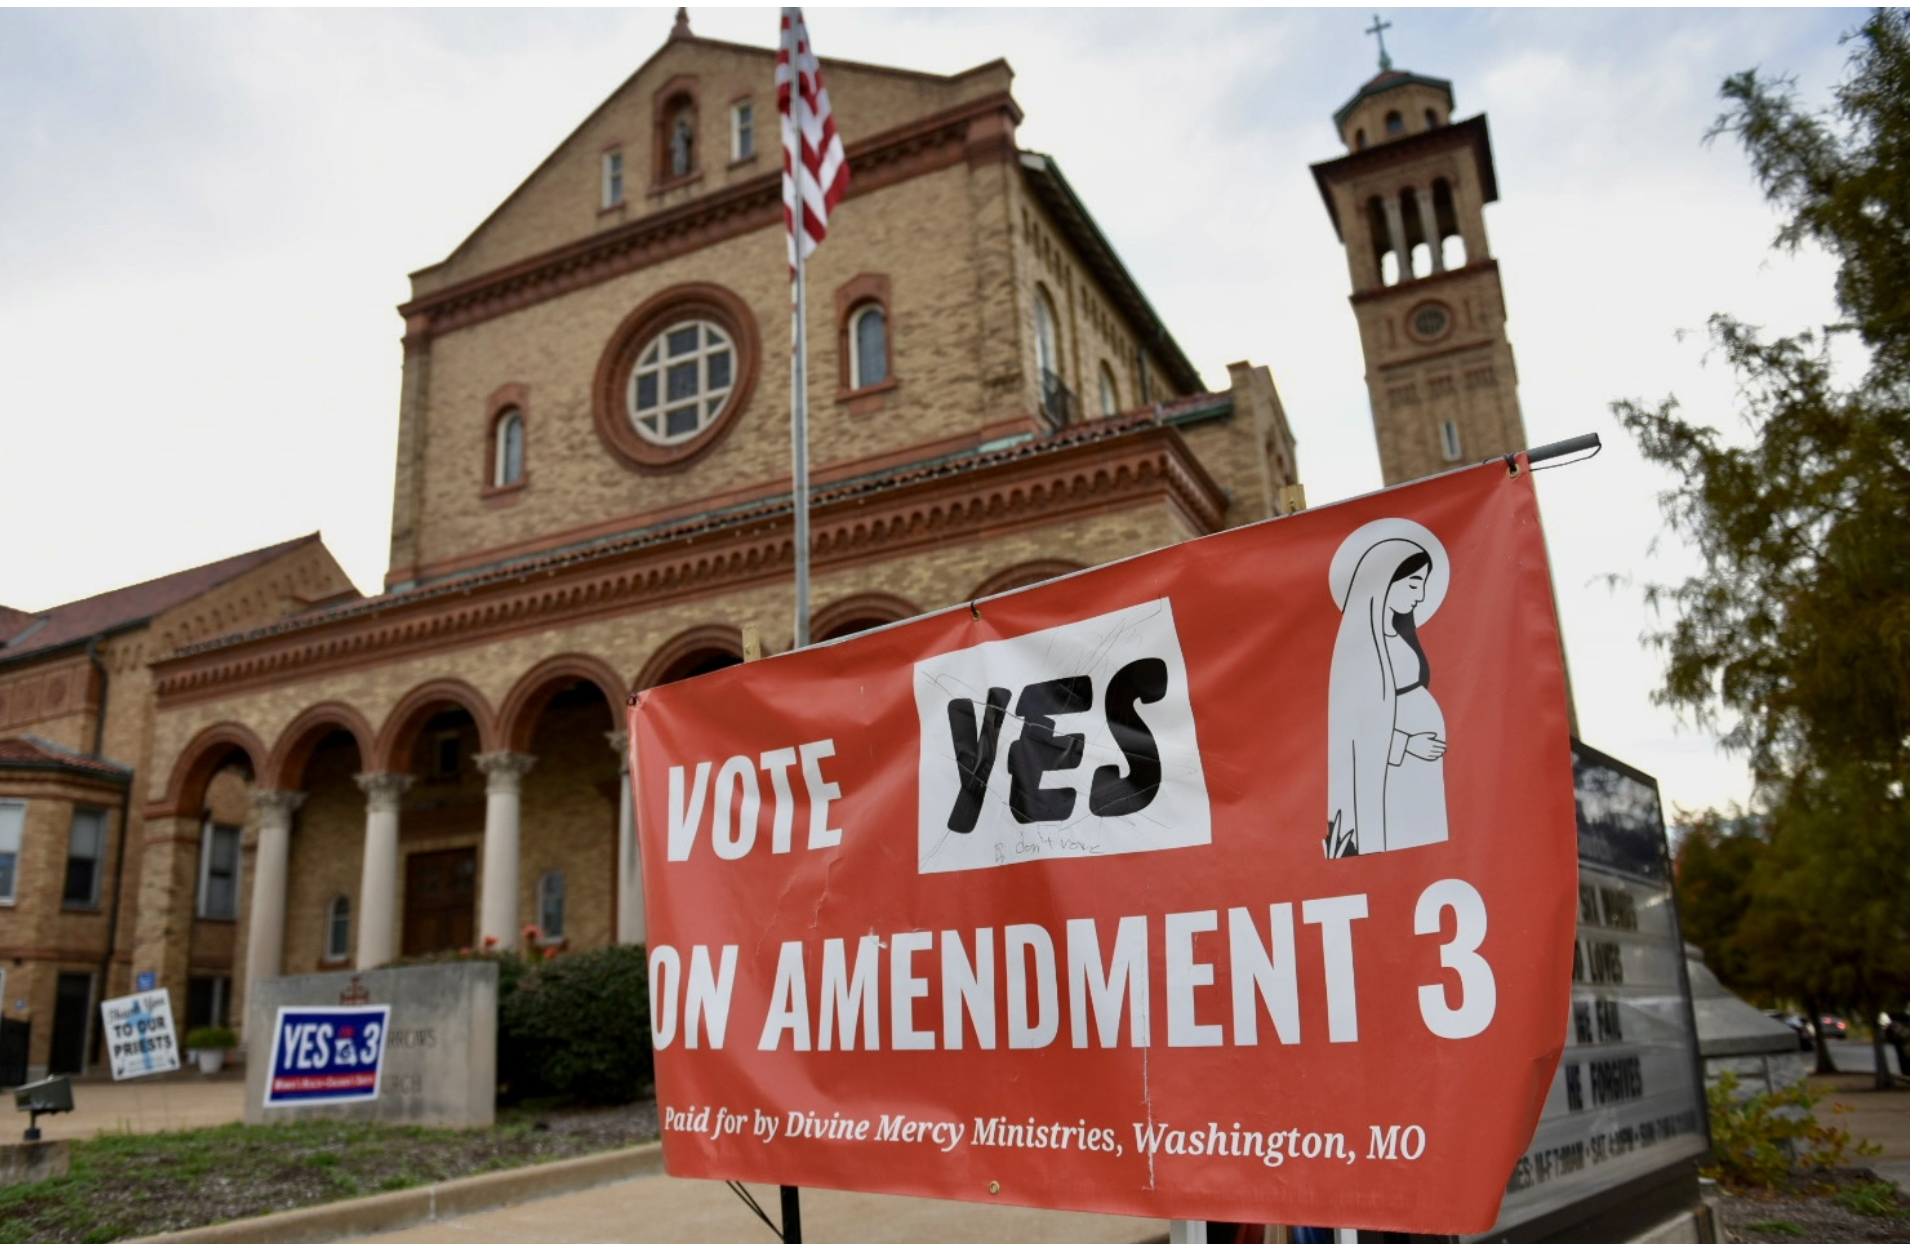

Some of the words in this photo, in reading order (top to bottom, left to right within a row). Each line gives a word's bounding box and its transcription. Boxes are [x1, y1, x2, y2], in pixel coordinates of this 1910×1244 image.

[667, 738, 843, 862] VOTE
[947, 656, 1168, 835] YES
[649, 944, 739, 1051] ON
[757, 893, 1369, 1052] AMENDMENT
[1413, 878, 1497, 1040] 3
[113, 1022, 133, 1038] TO
[137, 1016, 167, 1034] OUR
[113, 1034, 172, 1058] PRIESTS
[283, 1022, 334, 1070] YES
[360, 1022, 381, 1064] 3
[664, 1105, 711, 1132] Paid
[710, 1107, 748, 1140] for
[753, 1109, 779, 1143] by
[785, 1111, 870, 1141] Divine
[874, 1114, 965, 1152] Mercy
[971, 1116, 1124, 1157] Ministries,
[1132, 1122, 1356, 1168] Washington,
[1366, 1124, 1426, 1160] MO
